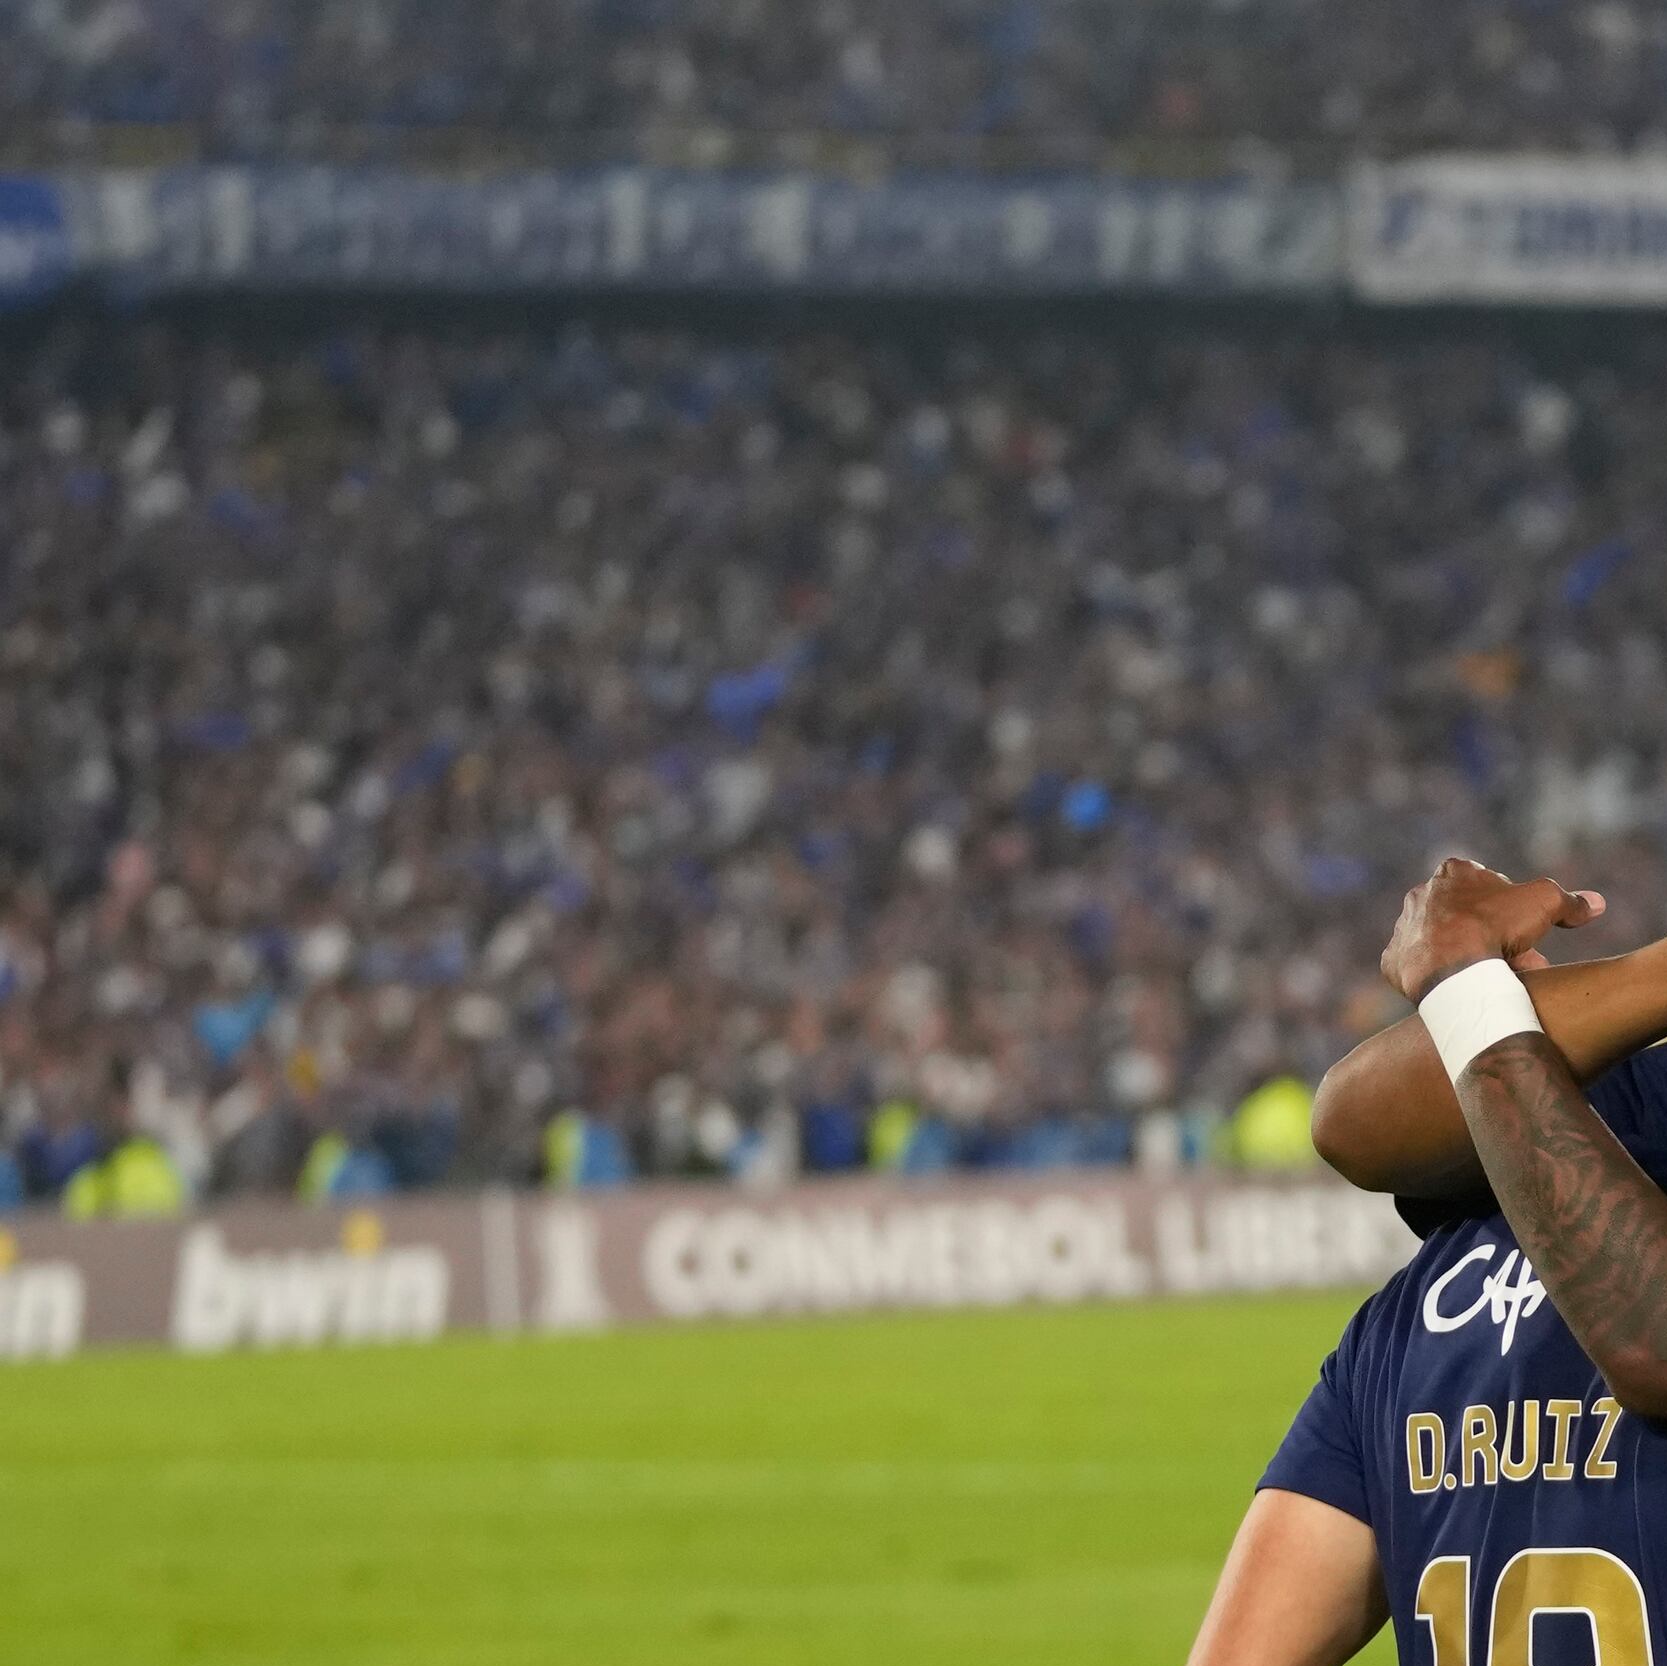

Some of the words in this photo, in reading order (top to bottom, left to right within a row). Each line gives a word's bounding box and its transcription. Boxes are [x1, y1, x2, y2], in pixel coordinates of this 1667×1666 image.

[172, 1208, 450, 1352] bwin
[643, 1196, 1148, 1320] CONMEBOL
[1406, 1395, 1624, 1495] D.RUIZ
